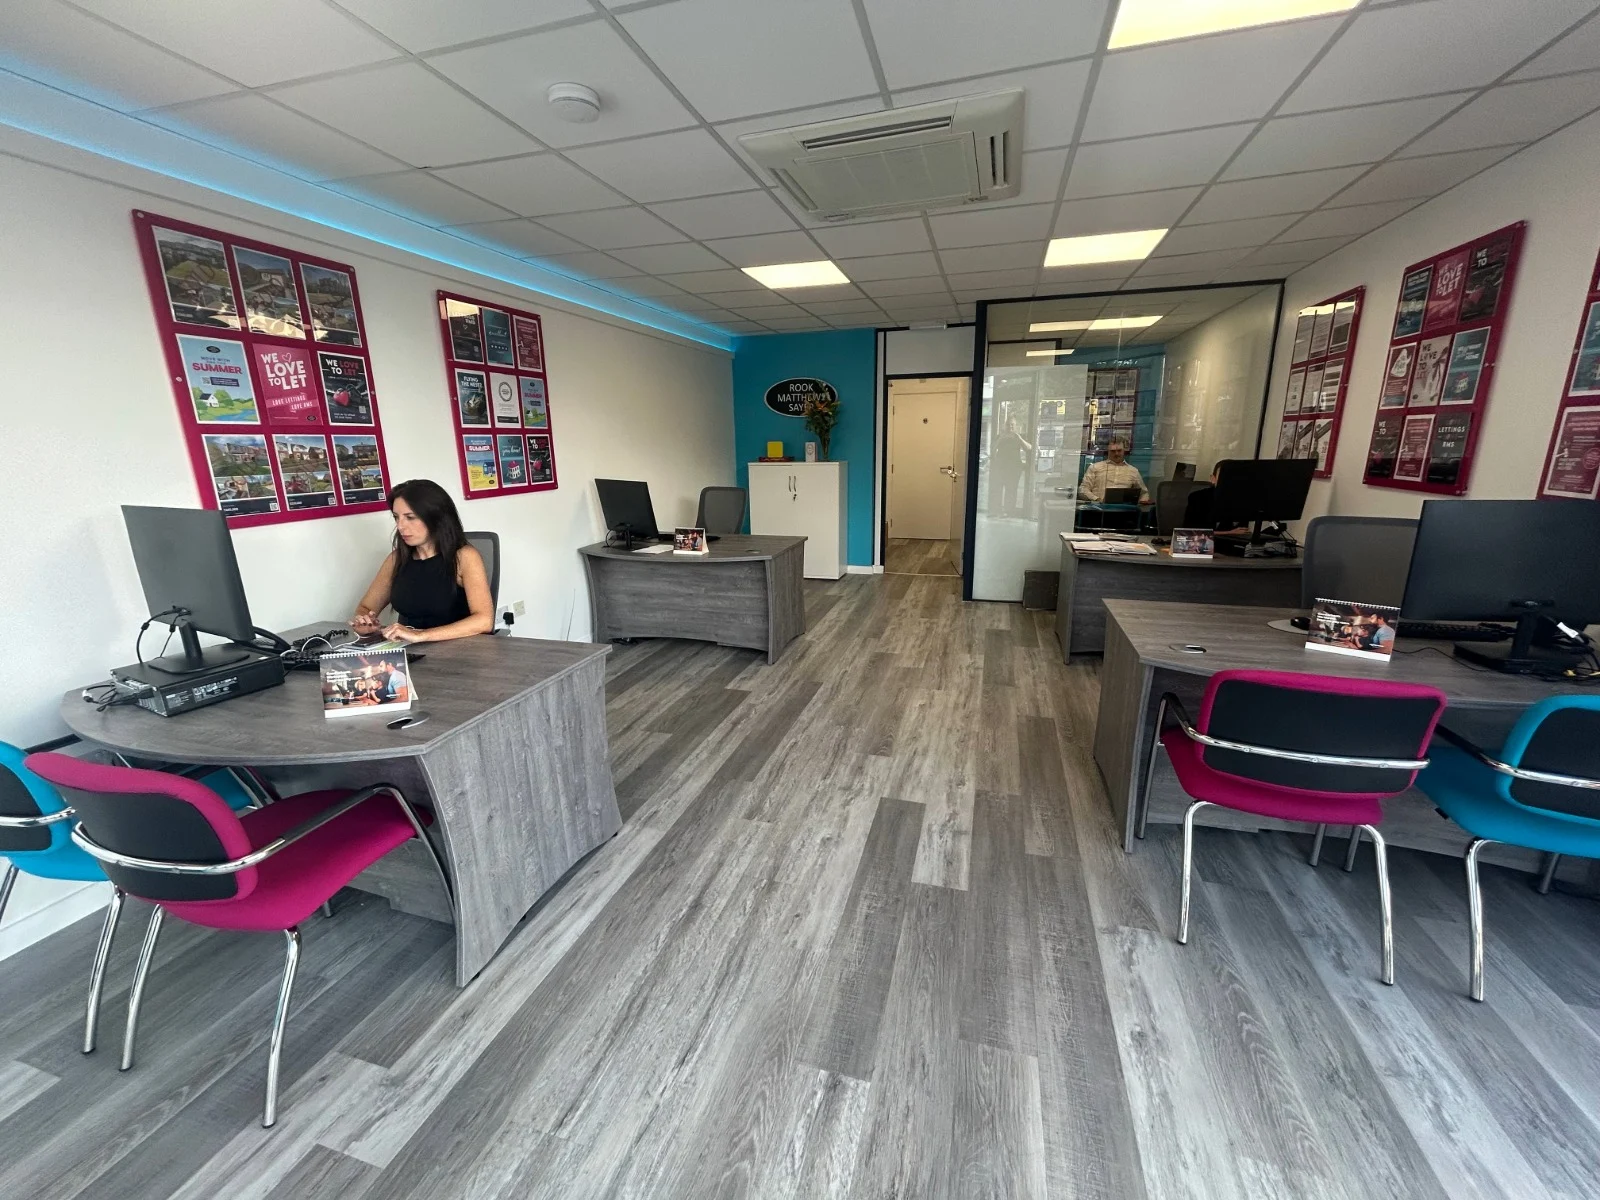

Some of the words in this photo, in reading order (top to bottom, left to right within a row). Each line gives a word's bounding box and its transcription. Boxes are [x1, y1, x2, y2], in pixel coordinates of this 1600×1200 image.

[1437, 263, 1463, 288] LOVE
[1441, 276, 1461, 297] LET
[260, 353, 279, 364] WE
[325, 358, 338, 367] WE
[339, 360, 359, 370] LOVE
[192, 362, 243, 375] SUMMER
[265, 360, 306, 378] LOVE
[331, 366, 343, 375] TO
[343, 367, 356, 376] LET
[268, 377, 281, 387] TO
[281, 374, 307, 390] LET
[789, 383, 814, 392] ROOK
[272, 398, 284, 406] LOVE
[285, 395, 306, 404] LETTINGS
